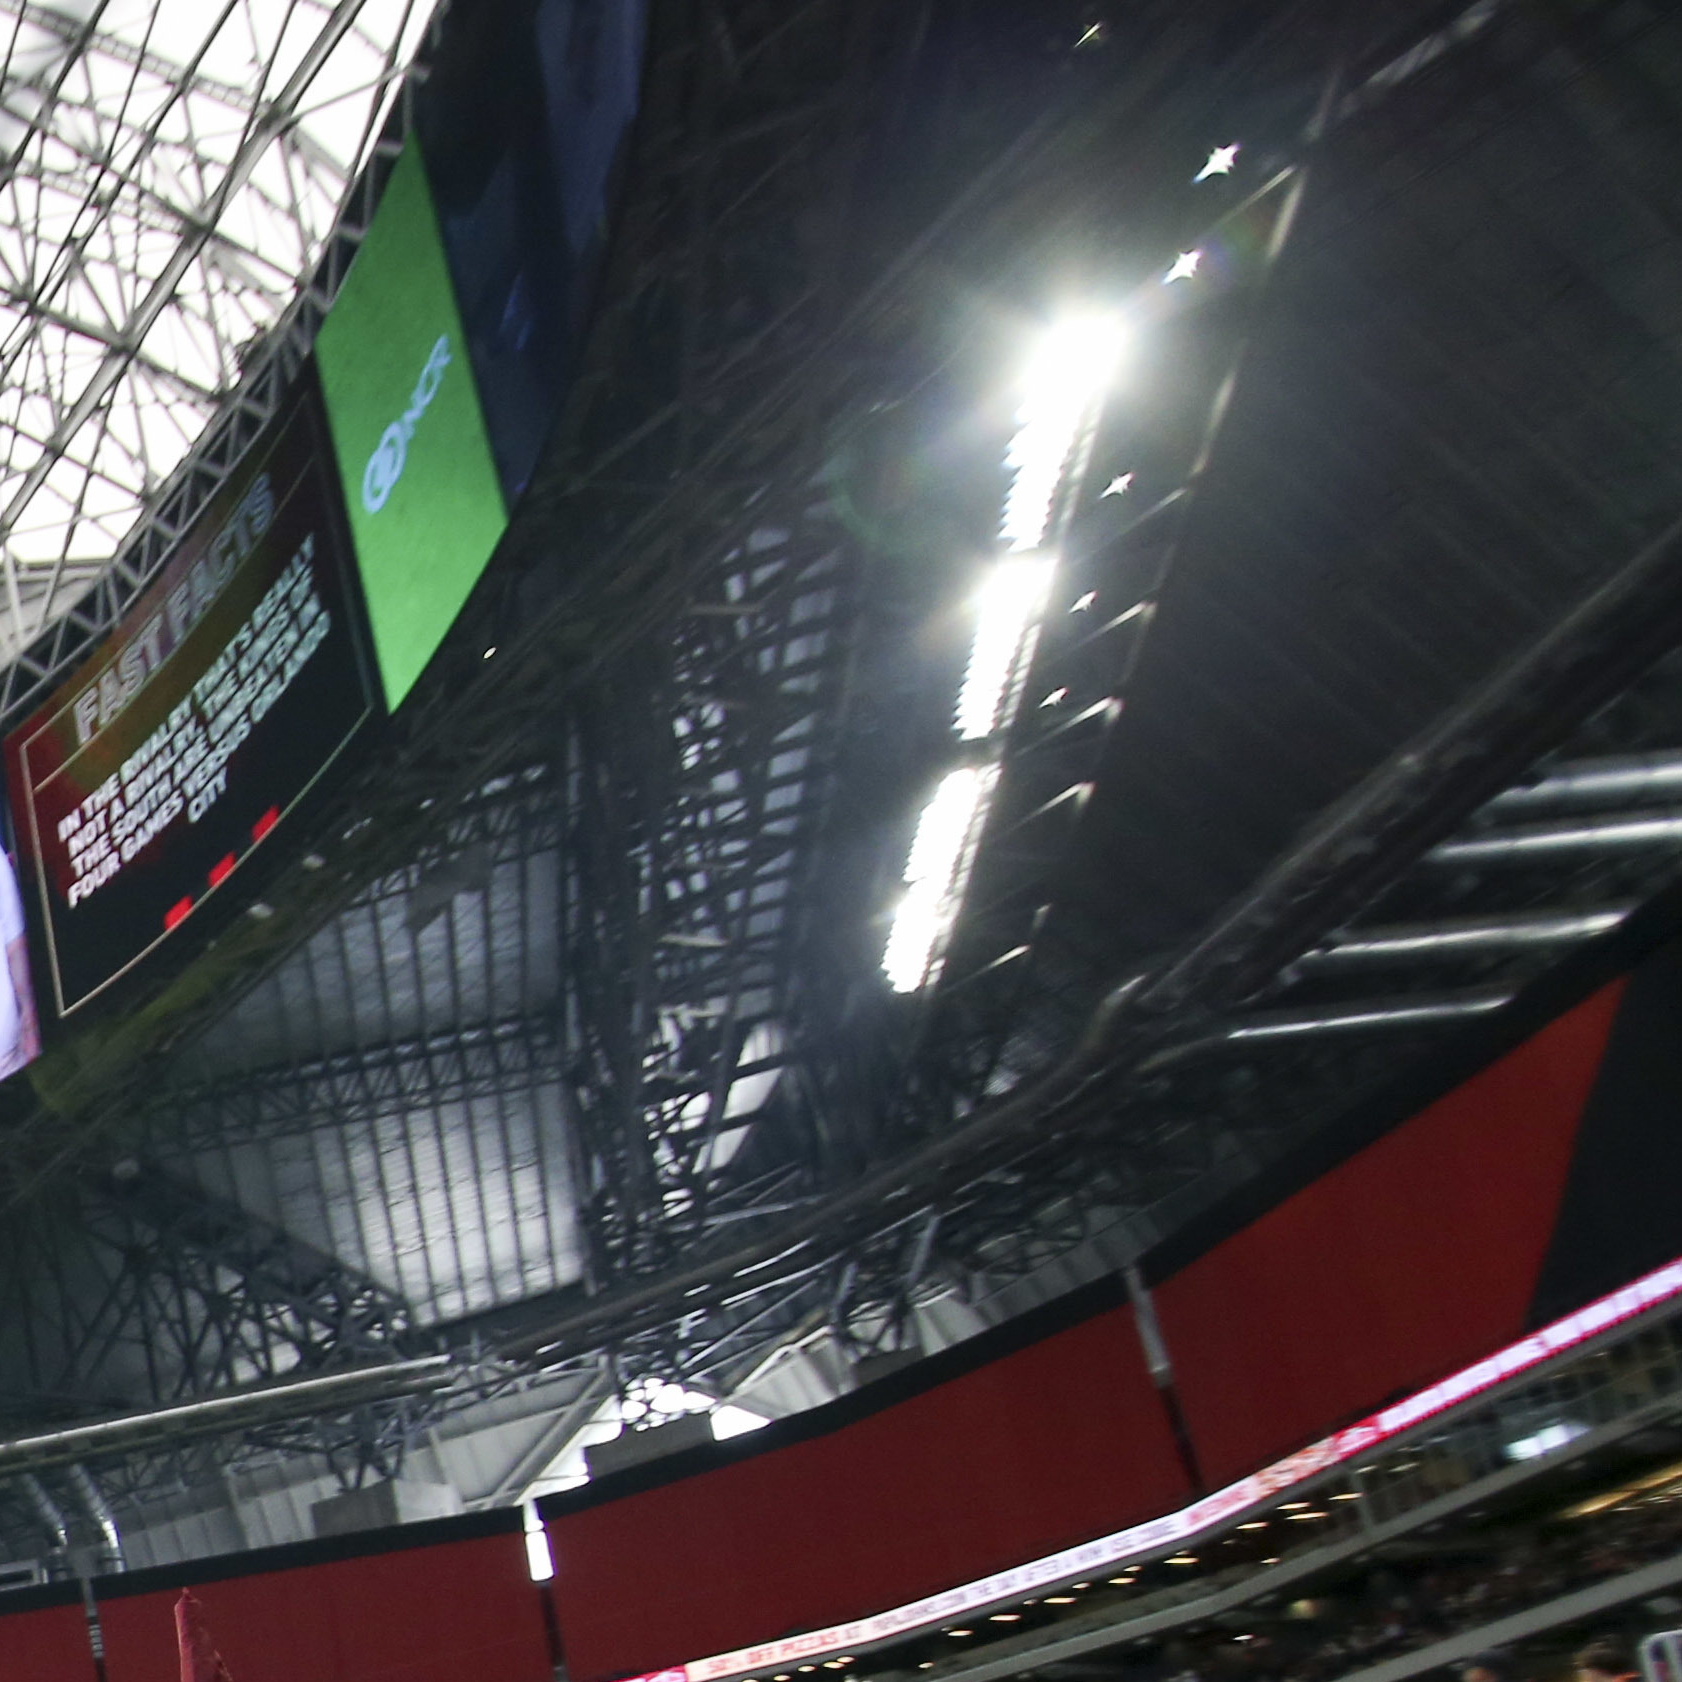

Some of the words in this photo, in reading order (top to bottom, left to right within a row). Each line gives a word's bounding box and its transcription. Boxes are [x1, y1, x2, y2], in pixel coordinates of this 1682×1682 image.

[73, 612, 164, 744] FAST
[165, 471, 276, 645] FACTS
[58, 808, 81, 842] IN
[81, 771, 121, 818] THE
[120, 692, 192, 785] RIVALRY
[187, 765, 228, 824] CITY
[67, 851, 121, 909] FOUR
[120, 788, 184, 863] GAMES
[68, 808, 107, 857] NOT
[109, 797, 125, 823] A
[71, 832, 111, 877] THE
[111, 772, 173, 846] SOUTH
